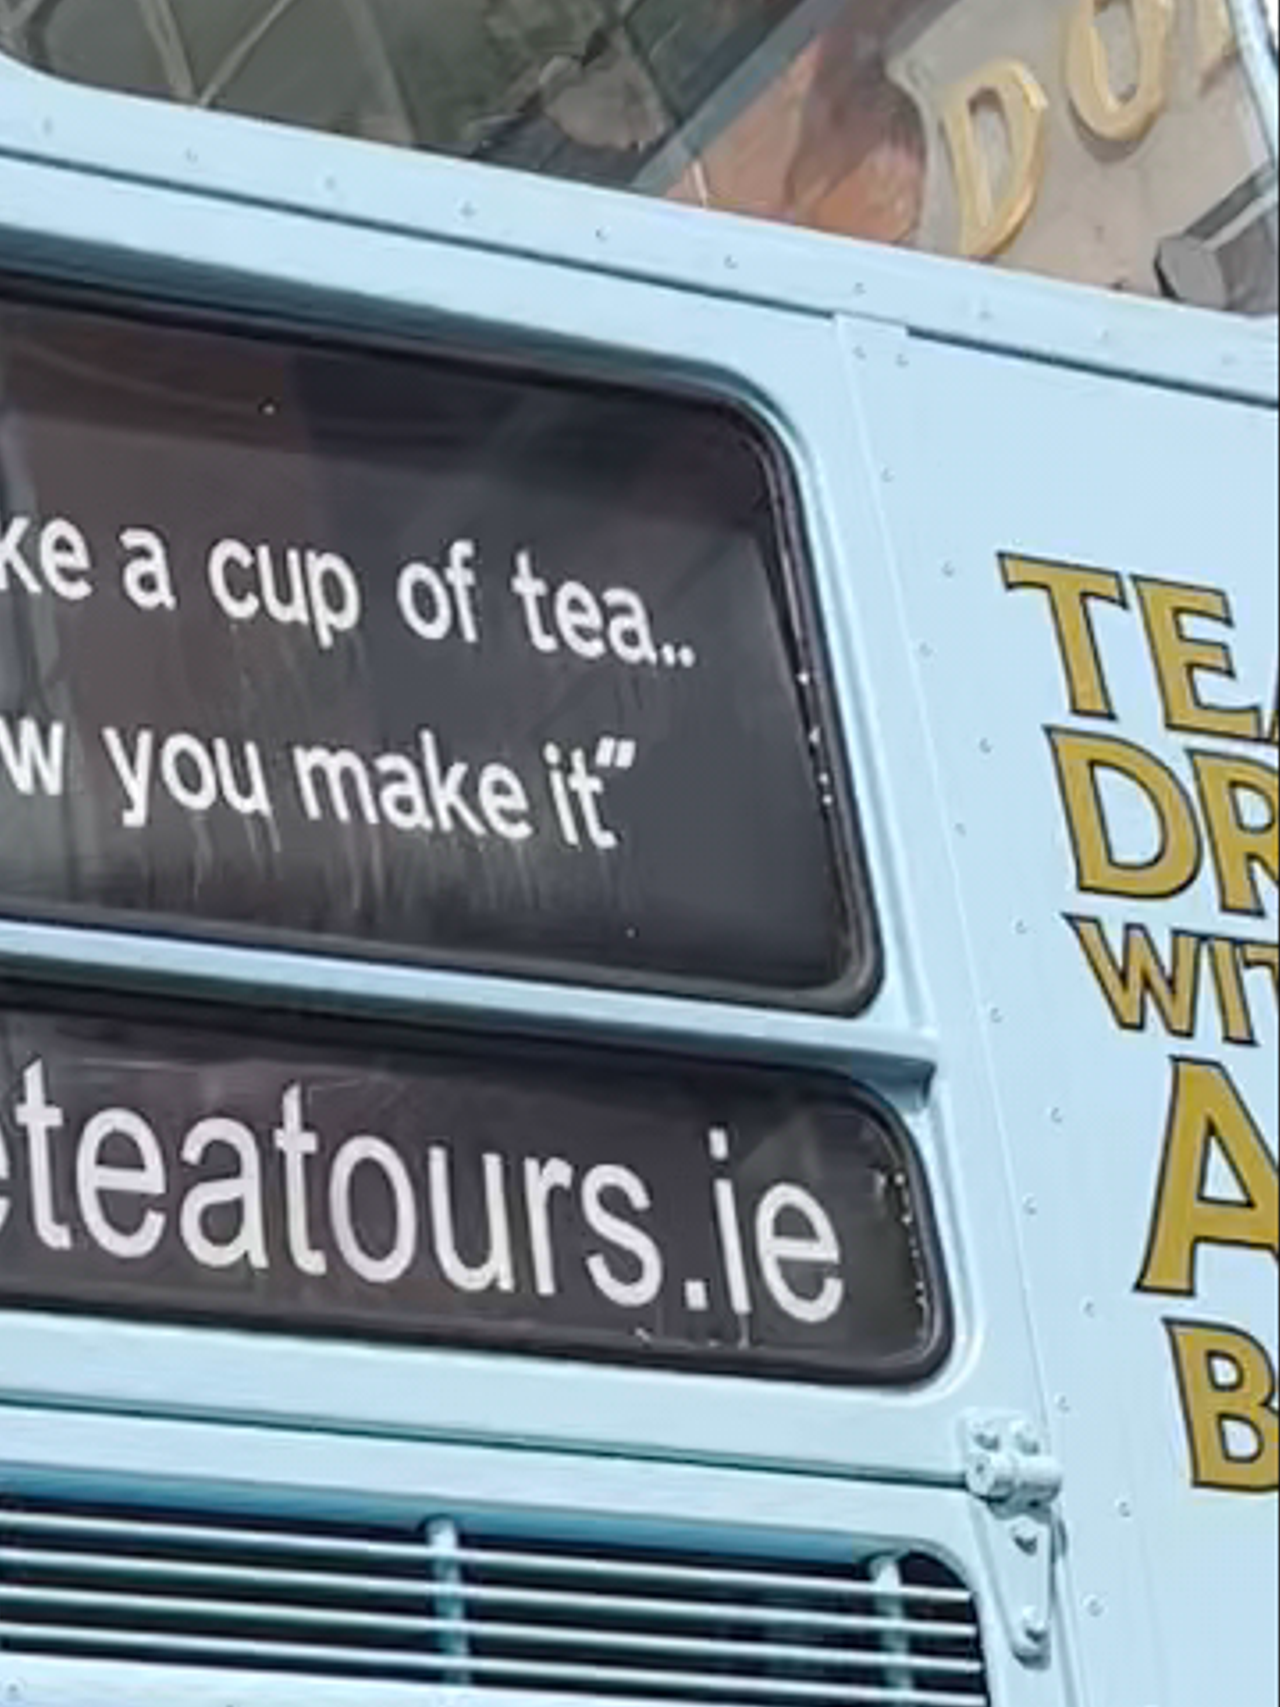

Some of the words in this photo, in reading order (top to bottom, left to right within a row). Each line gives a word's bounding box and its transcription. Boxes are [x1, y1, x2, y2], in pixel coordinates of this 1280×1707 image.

[118, 527, 177, 611] a
[208, 538, 361, 650] cup
[396, 539, 478, 643] of
[511, 549, 696, 668] tea..
[995, 550, 1278, 747] TE
[102, 726, 273, 827] you
[292, 728, 534, 840] make
